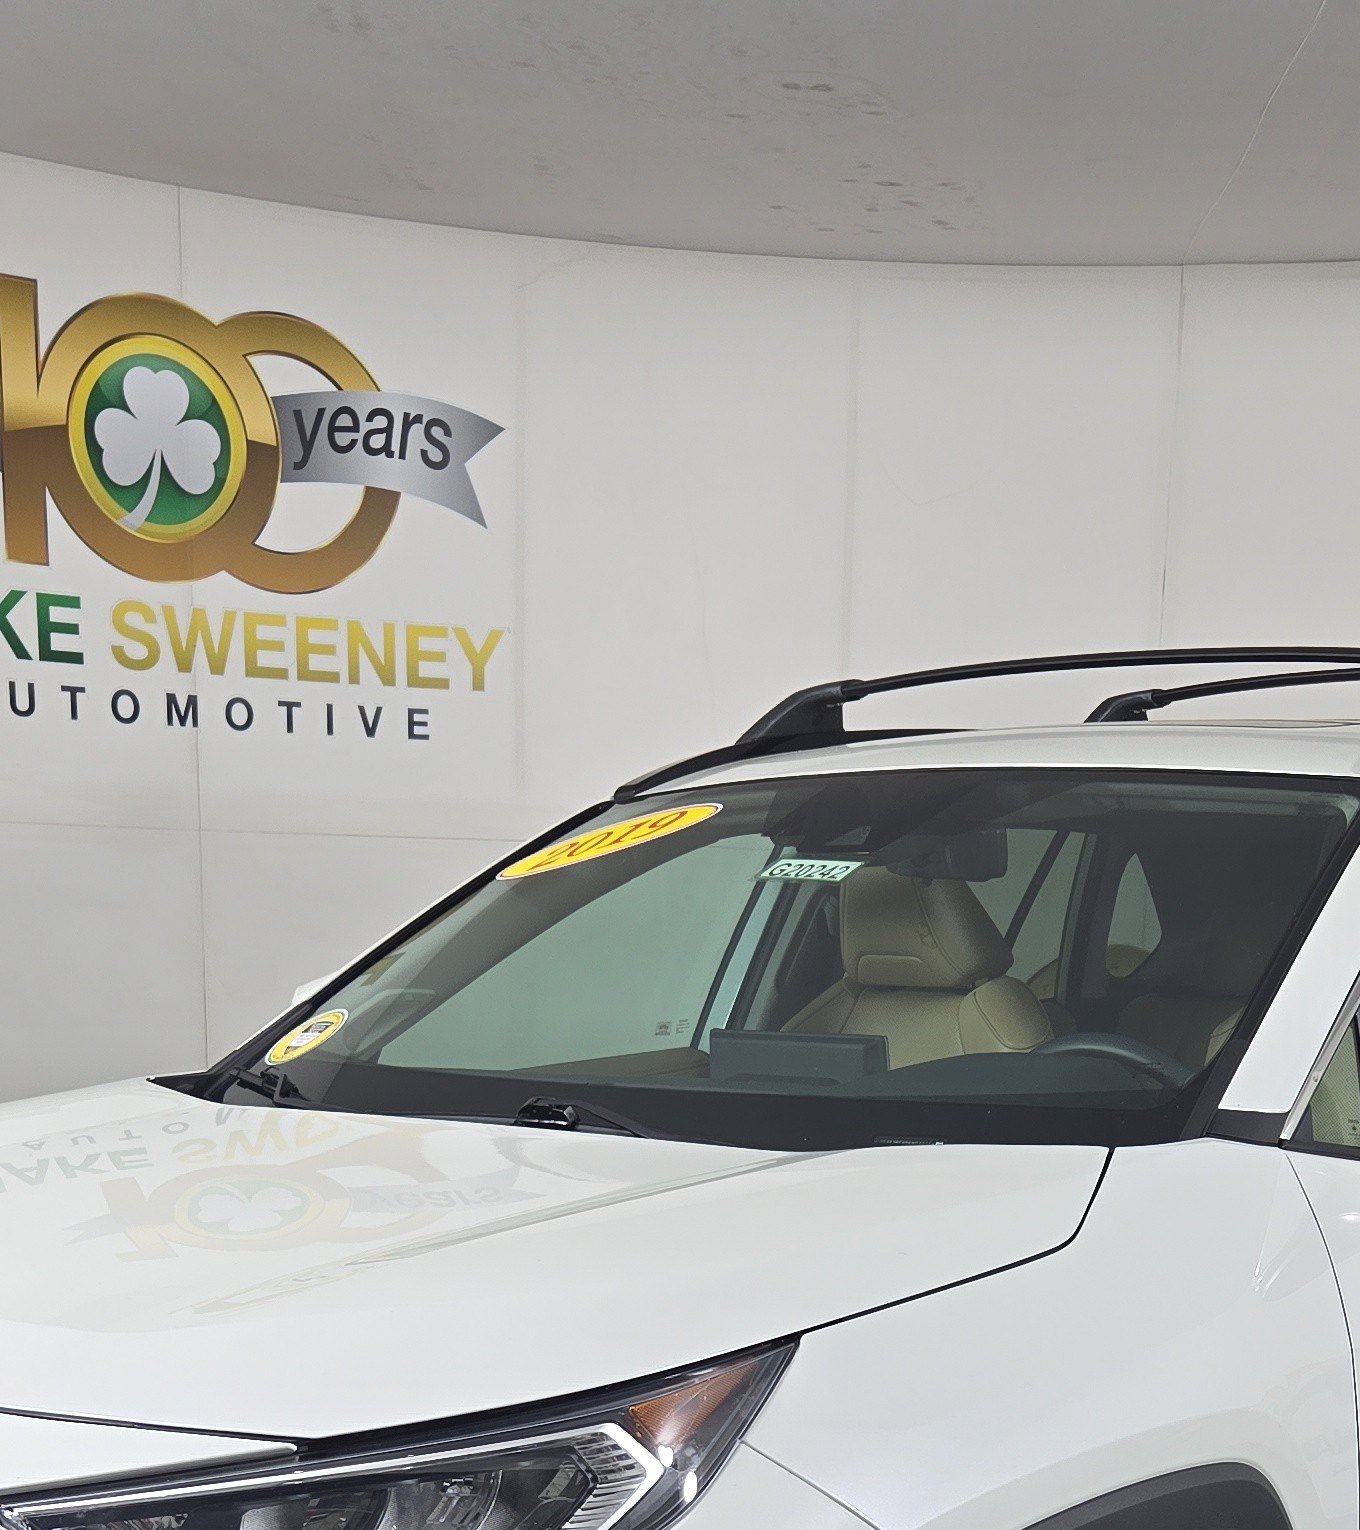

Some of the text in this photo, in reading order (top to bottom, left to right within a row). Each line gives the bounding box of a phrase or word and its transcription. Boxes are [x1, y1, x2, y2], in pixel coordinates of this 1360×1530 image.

[293, 404, 453, 471] years
[111, 600, 504, 692] SWEENEY
[527, 810, 688, 872] 2019
[768, 861, 852, 881] G20242
